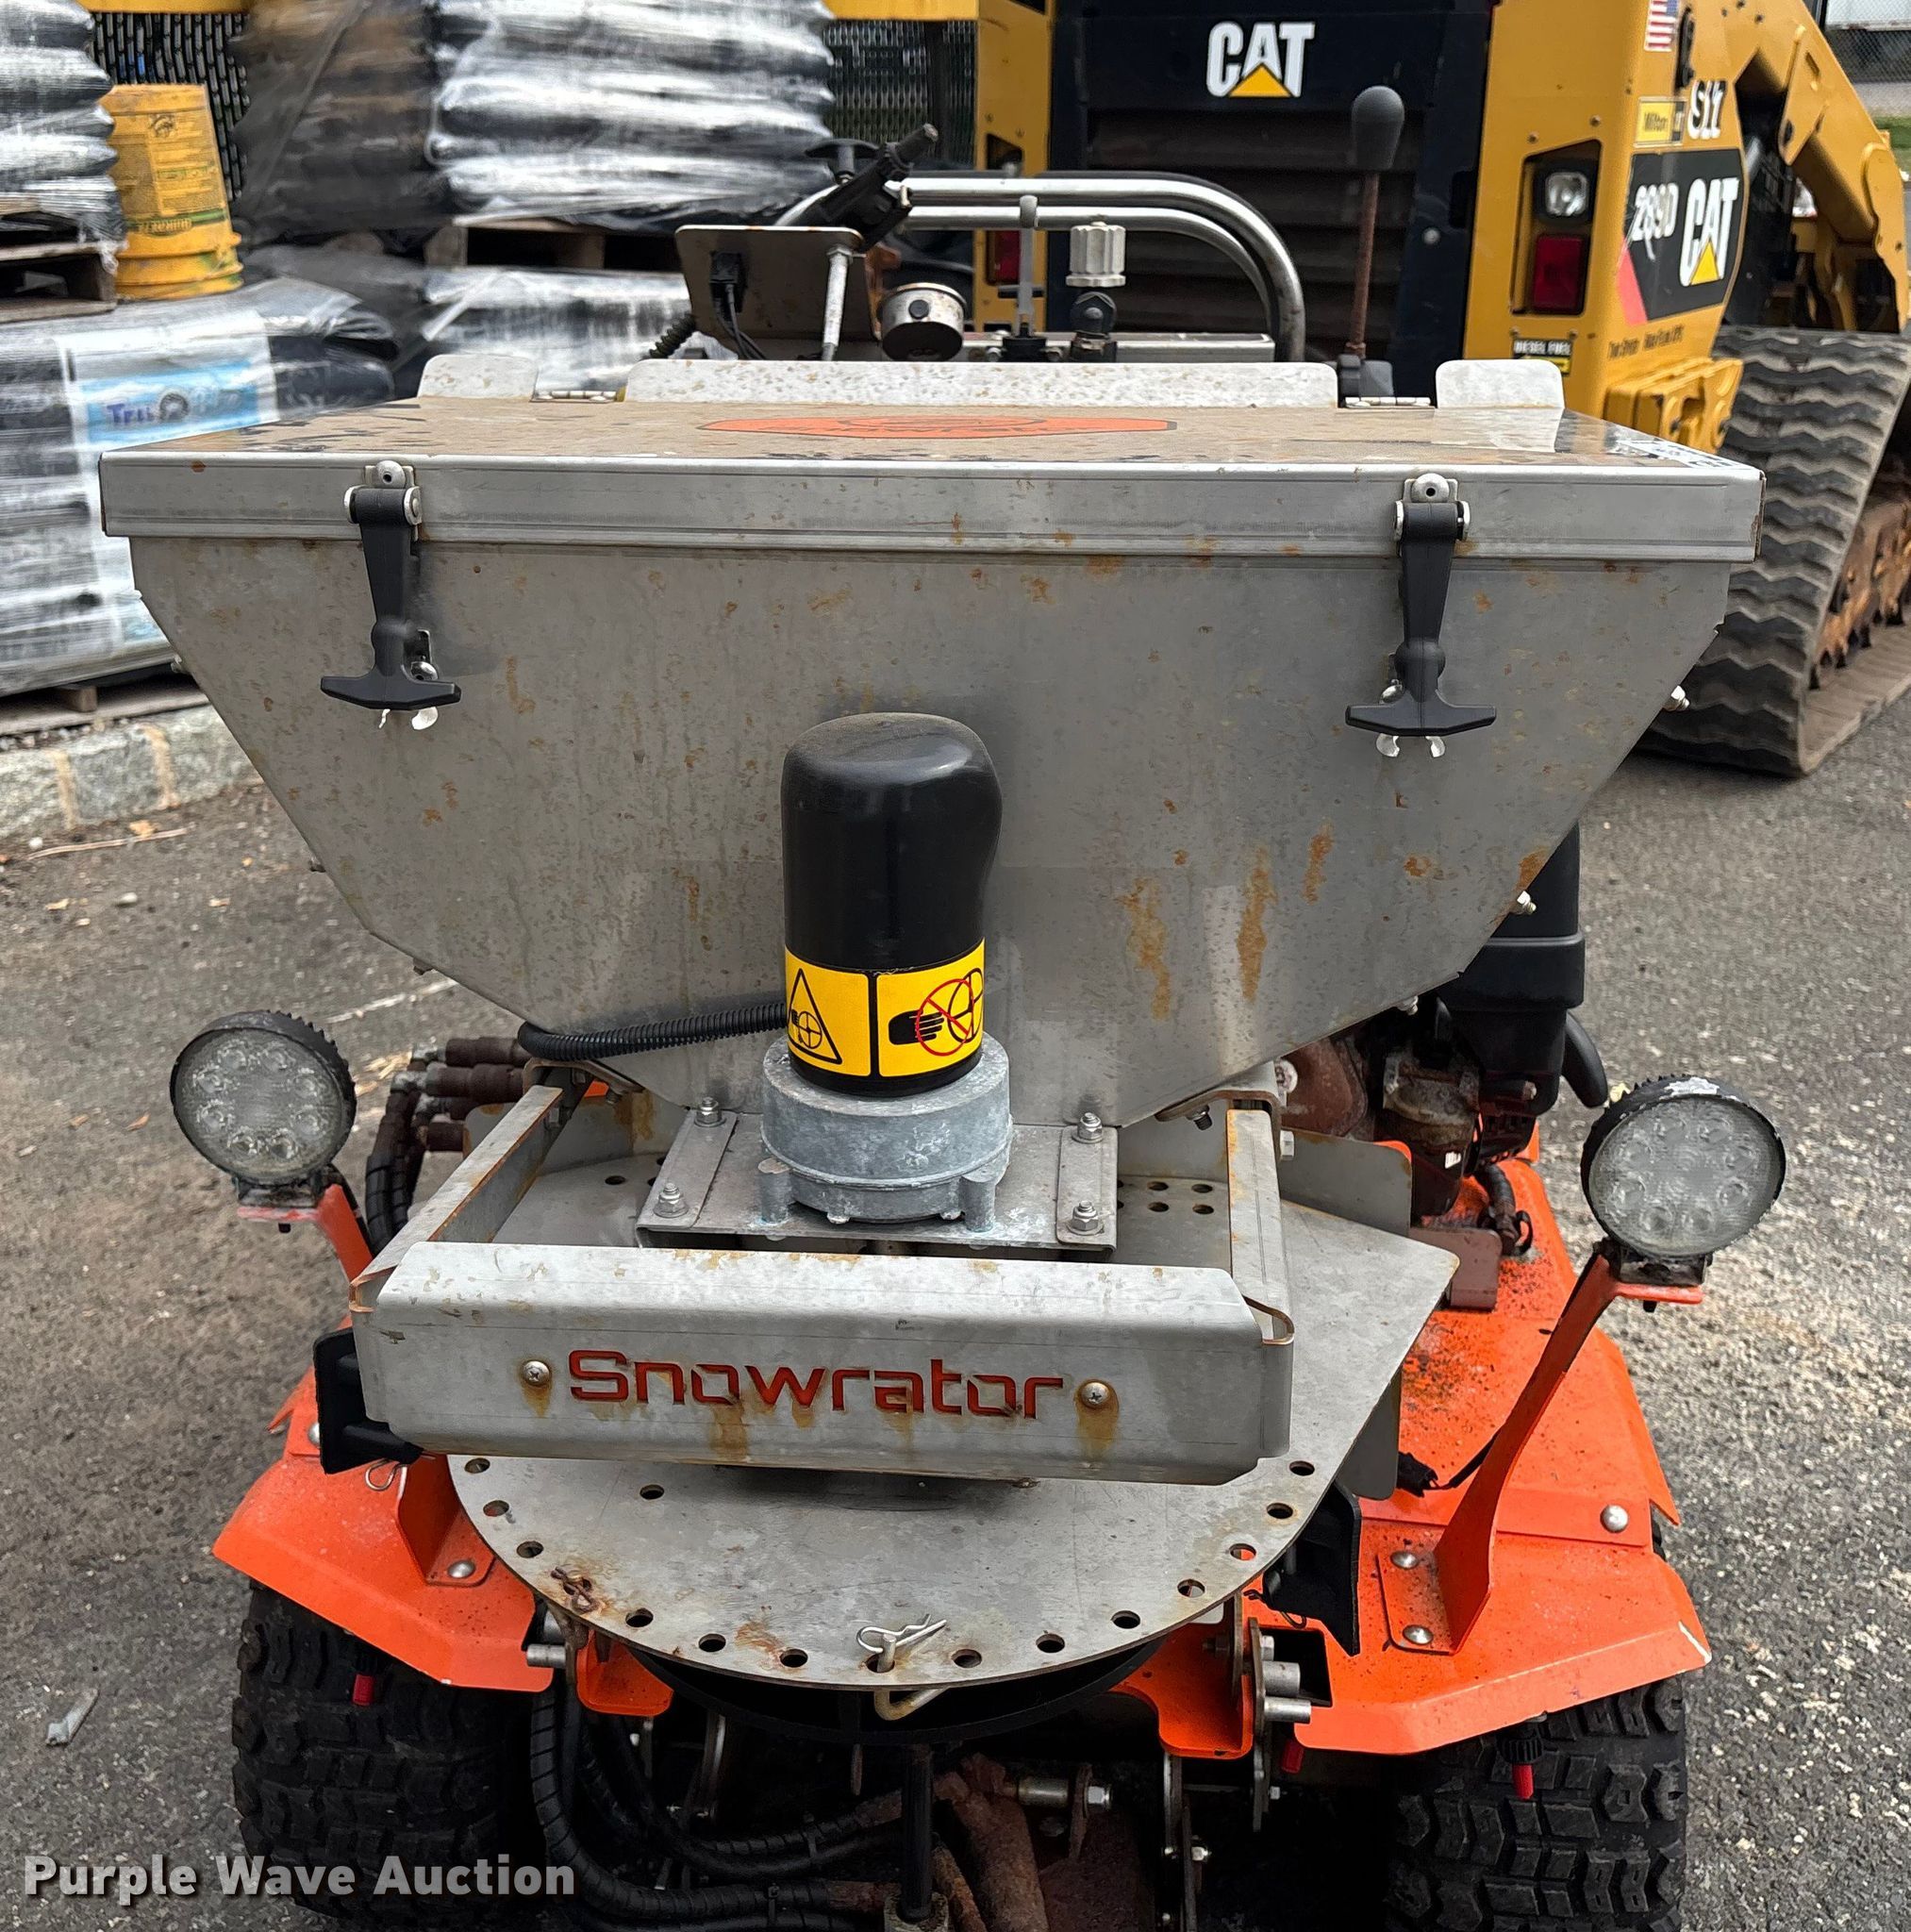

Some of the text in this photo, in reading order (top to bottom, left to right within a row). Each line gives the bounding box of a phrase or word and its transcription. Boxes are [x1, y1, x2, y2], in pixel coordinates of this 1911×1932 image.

[1206, 21, 1316, 97] CAT
[1679, 176, 1739, 287] CAT
[568, 1350, 1064, 1420] Snowrator
